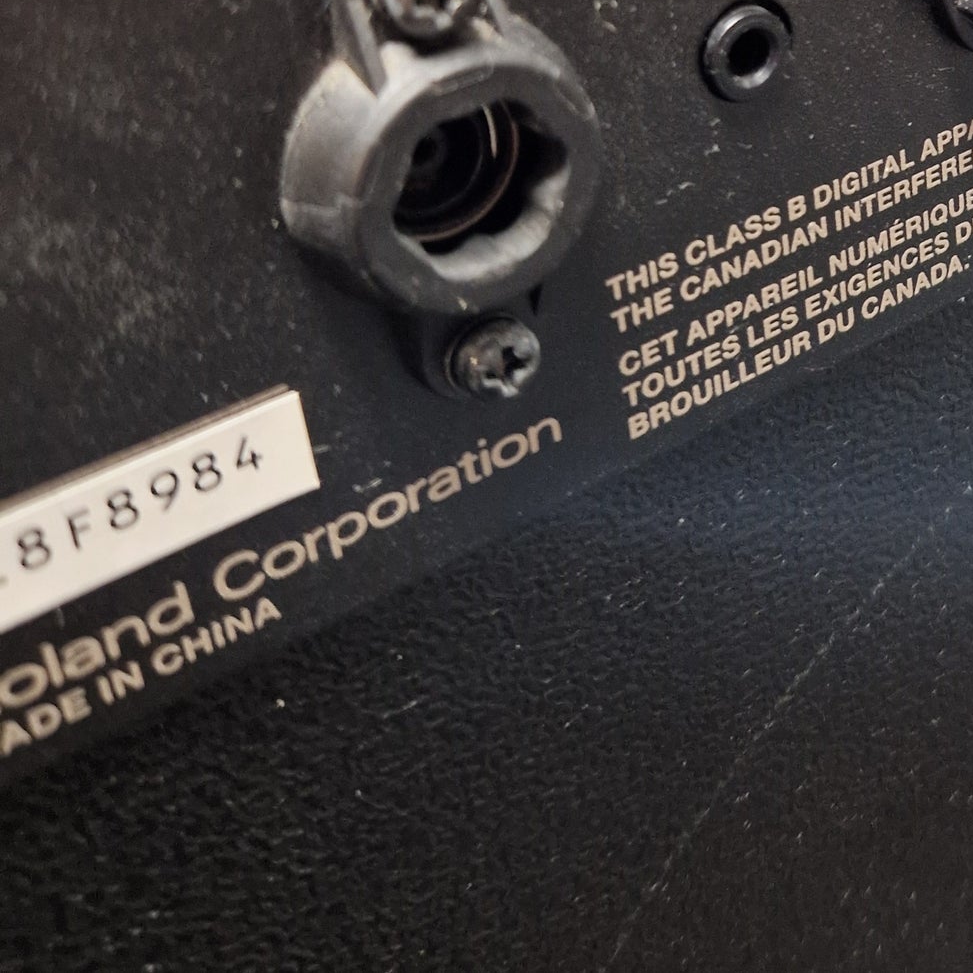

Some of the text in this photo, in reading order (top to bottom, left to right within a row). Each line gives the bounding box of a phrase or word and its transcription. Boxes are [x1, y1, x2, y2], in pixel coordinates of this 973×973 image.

[605, 252, 679, 300] THIS
[684, 206, 782, 266] CLASS
[786, 195, 807, 222] B
[813, 148, 916, 211] DIGITAL
[610, 287, 675, 334] THE
[679, 216, 829, 302] CANADIAN
[618, 329, 679, 376] CET
[686, 267, 824, 347] APPAREIL
[622, 334, 741, 407] TOUTES
[746, 306, 800, 348] LES
[804, 232, 951, 321] EXIGENCES
[627, 329, 812, 441] BROUILLEUR
[818, 308, 856, 346] DU
[0, 435, 264, 585] 8F8984
[0, 416, 564, 709] oland Corporation
[0, 596, 282, 756] ADE IN CHINA
